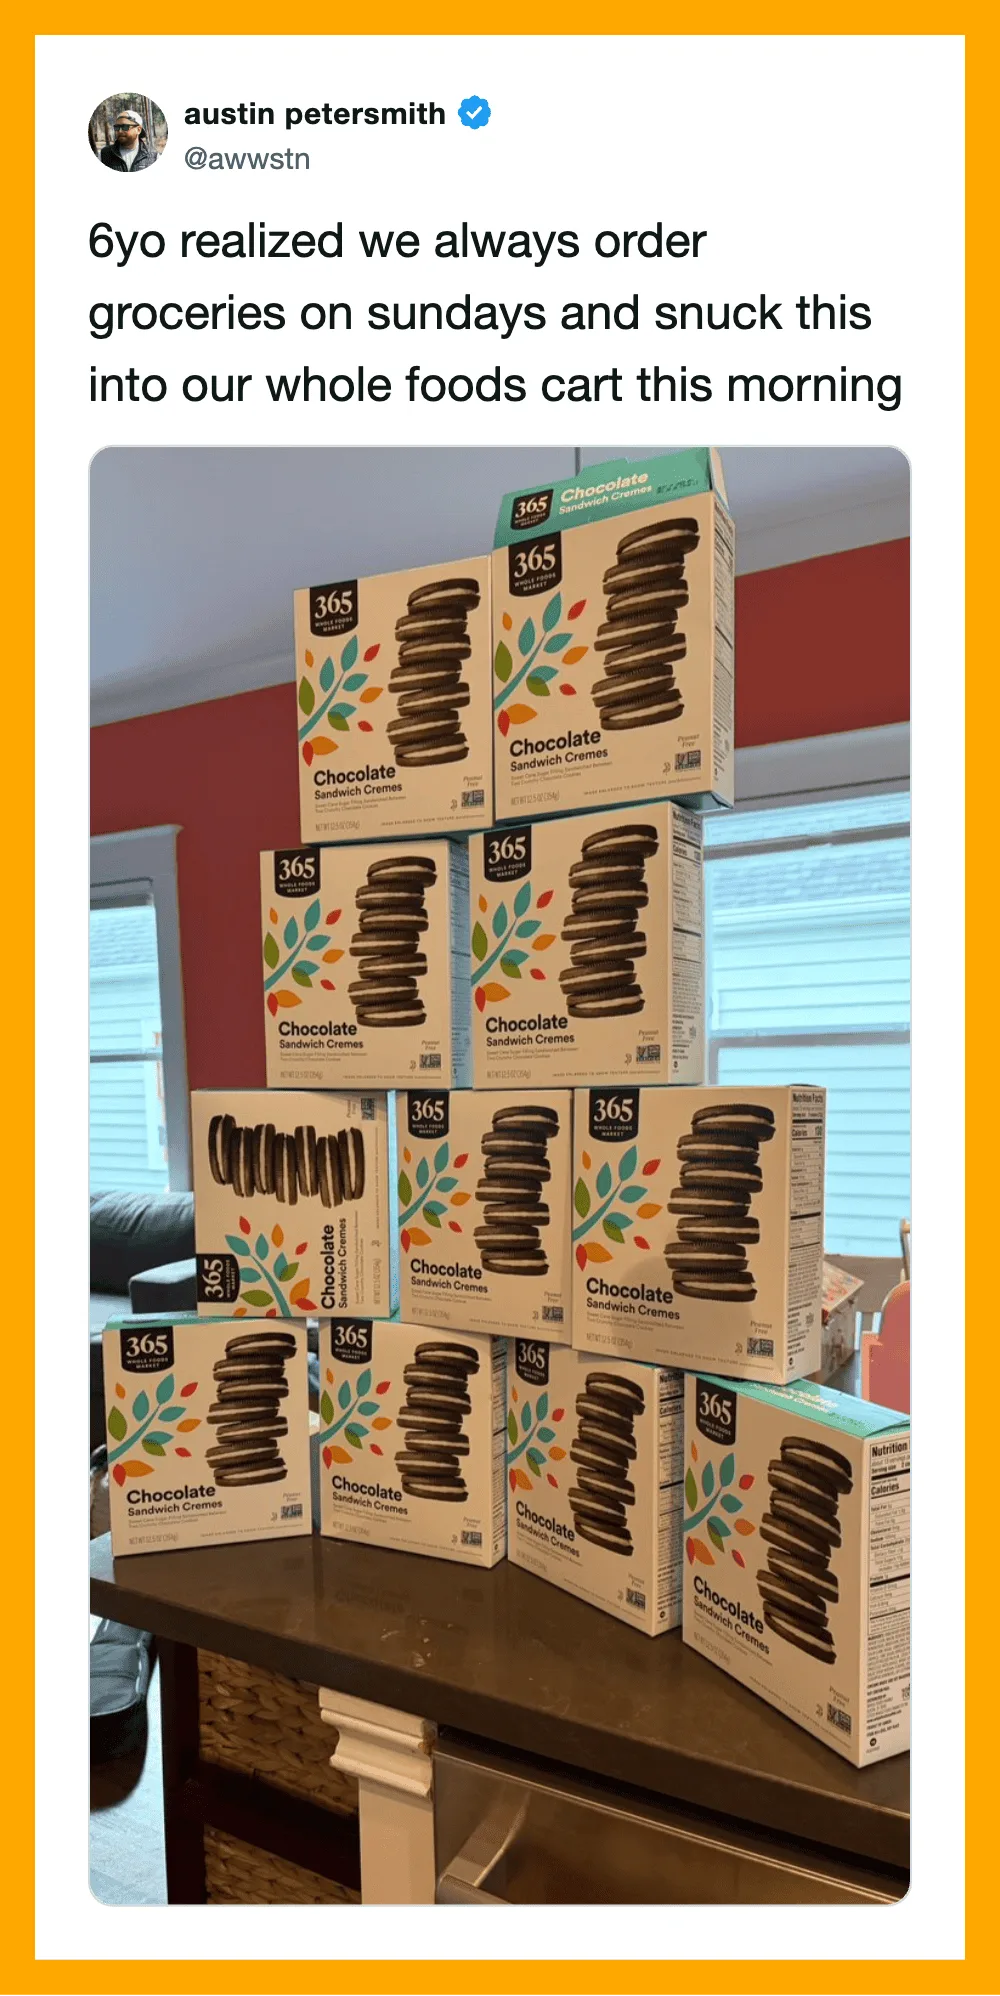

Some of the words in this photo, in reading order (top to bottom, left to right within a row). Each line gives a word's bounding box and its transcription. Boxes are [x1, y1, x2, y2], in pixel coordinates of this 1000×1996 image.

[560, 472, 649, 503] Chocolate
[515, 495, 549, 518] 365
[559, 495, 609, 515] Sandwich
[610, 485, 653, 500] Cremes
[513, 543, 556, 578] 365
[514, 577, 535, 587] WHOLE
[536, 572, 556, 580] FOODS
[523, 581, 547, 591] MARKET
[314, 590, 352, 619] 365
[509, 729, 601, 757] Chocolate
[510, 754, 562, 772] Sandwich
[564, 748, 608, 763] Cremes
[313, 764, 396, 786] Chocolate
[314, 785, 362, 800] Sandwich
[363, 783, 403, 795] Cremes
[488, 835, 526, 864] 365
[279, 855, 315, 880] 365
[278, 1020, 358, 1036] Chocolate
[485, 1013, 568, 1033] Chocolate
[279, 1039, 324, 1049] Sandwich
[326, 1039, 364, 1049] Cremes
[486, 1034, 533, 1047] Sandwich
[535, 1033, 575, 1044] Cremes
[411, 1097, 444, 1121] 365
[593, 1096, 633, 1122] 365
[337, 1218, 347, 1257] Cremes
[201, 1259, 224, 1298] 365
[320, 1224, 335, 1310] Chocolate
[410, 1258, 482, 1280] Chocolate
[338, 1258, 347, 1309] Sandwich
[411, 1276, 451, 1289] Sandwich
[453, 1280, 488, 1294] Cremes
[586, 1277, 673, 1304] Chocolate
[586, 1297, 635, 1314] Sandwich
[637, 1304, 680, 1320] Cremes
[126, 1333, 168, 1357] 365
[334, 1324, 367, 1348] 365
[518, 1342, 545, 1369] 365
[699, 1391, 732, 1425] 365
[871, 1442, 908, 1457] Nutrition
[126, 1484, 216, 1504] Chocolate
[332, 1475, 402, 1502] Chocolate
[871, 1483, 900, 1495] Calories
[128, 1503, 180, 1516] Sandwich
[182, 1500, 223, 1511] Cremes
[332, 1491, 373, 1508] Sandwich
[373, 1501, 408, 1515] Cremes
[516, 1500, 575, 1542] Chocolate
[516, 1518, 550, 1542] Sandwich
[550, 1535, 580, 1558] Cremes
[693, 1575, 764, 1634] Chocolate
[694, 1595, 733, 1630] Sandwich
[734, 1623, 770, 1655] Cremes
